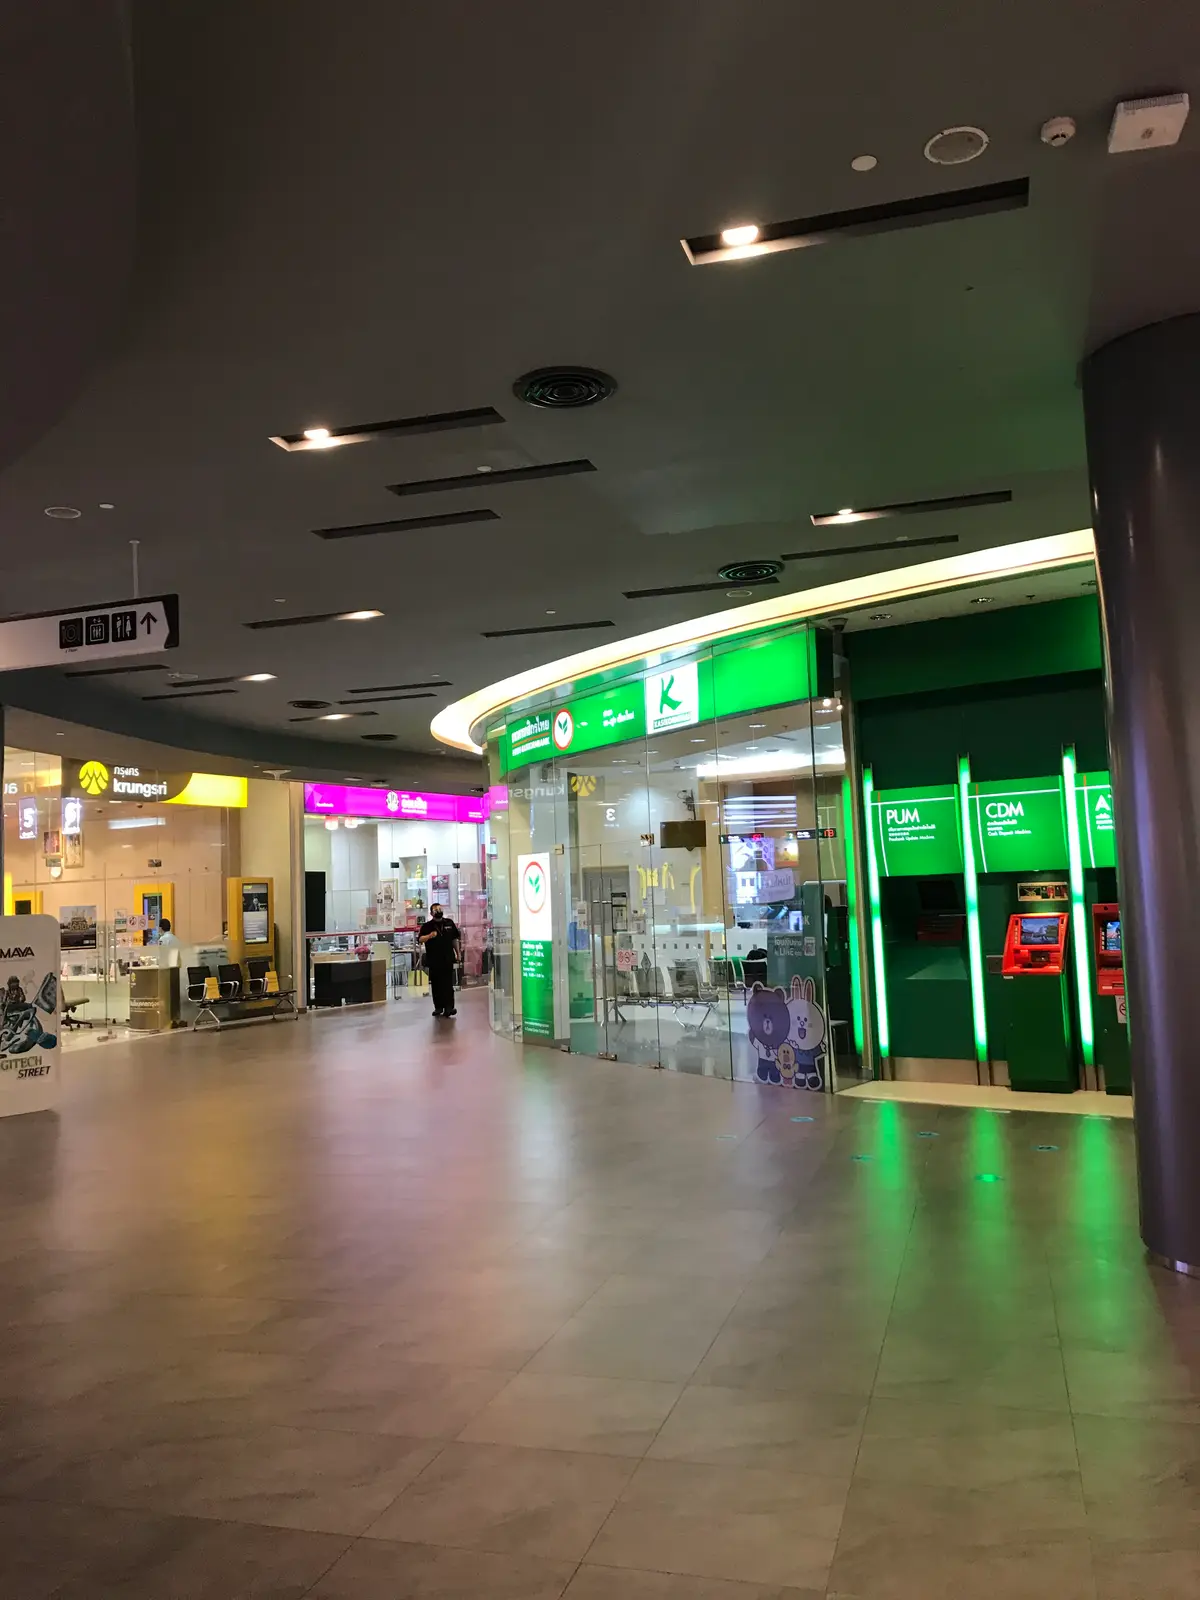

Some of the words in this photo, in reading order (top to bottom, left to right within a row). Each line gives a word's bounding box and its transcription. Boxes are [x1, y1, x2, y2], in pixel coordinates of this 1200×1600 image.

[660, 675, 682, 714] K
[113, 778, 167, 797] krungsri
[886, 808, 920, 825] PUM
[985, 801, 1025, 818] CDM
[0, 946, 35, 959] MAYA
[1, 1056, 42, 1070] GITECH
[18, 1066, 51, 1079] STREET
